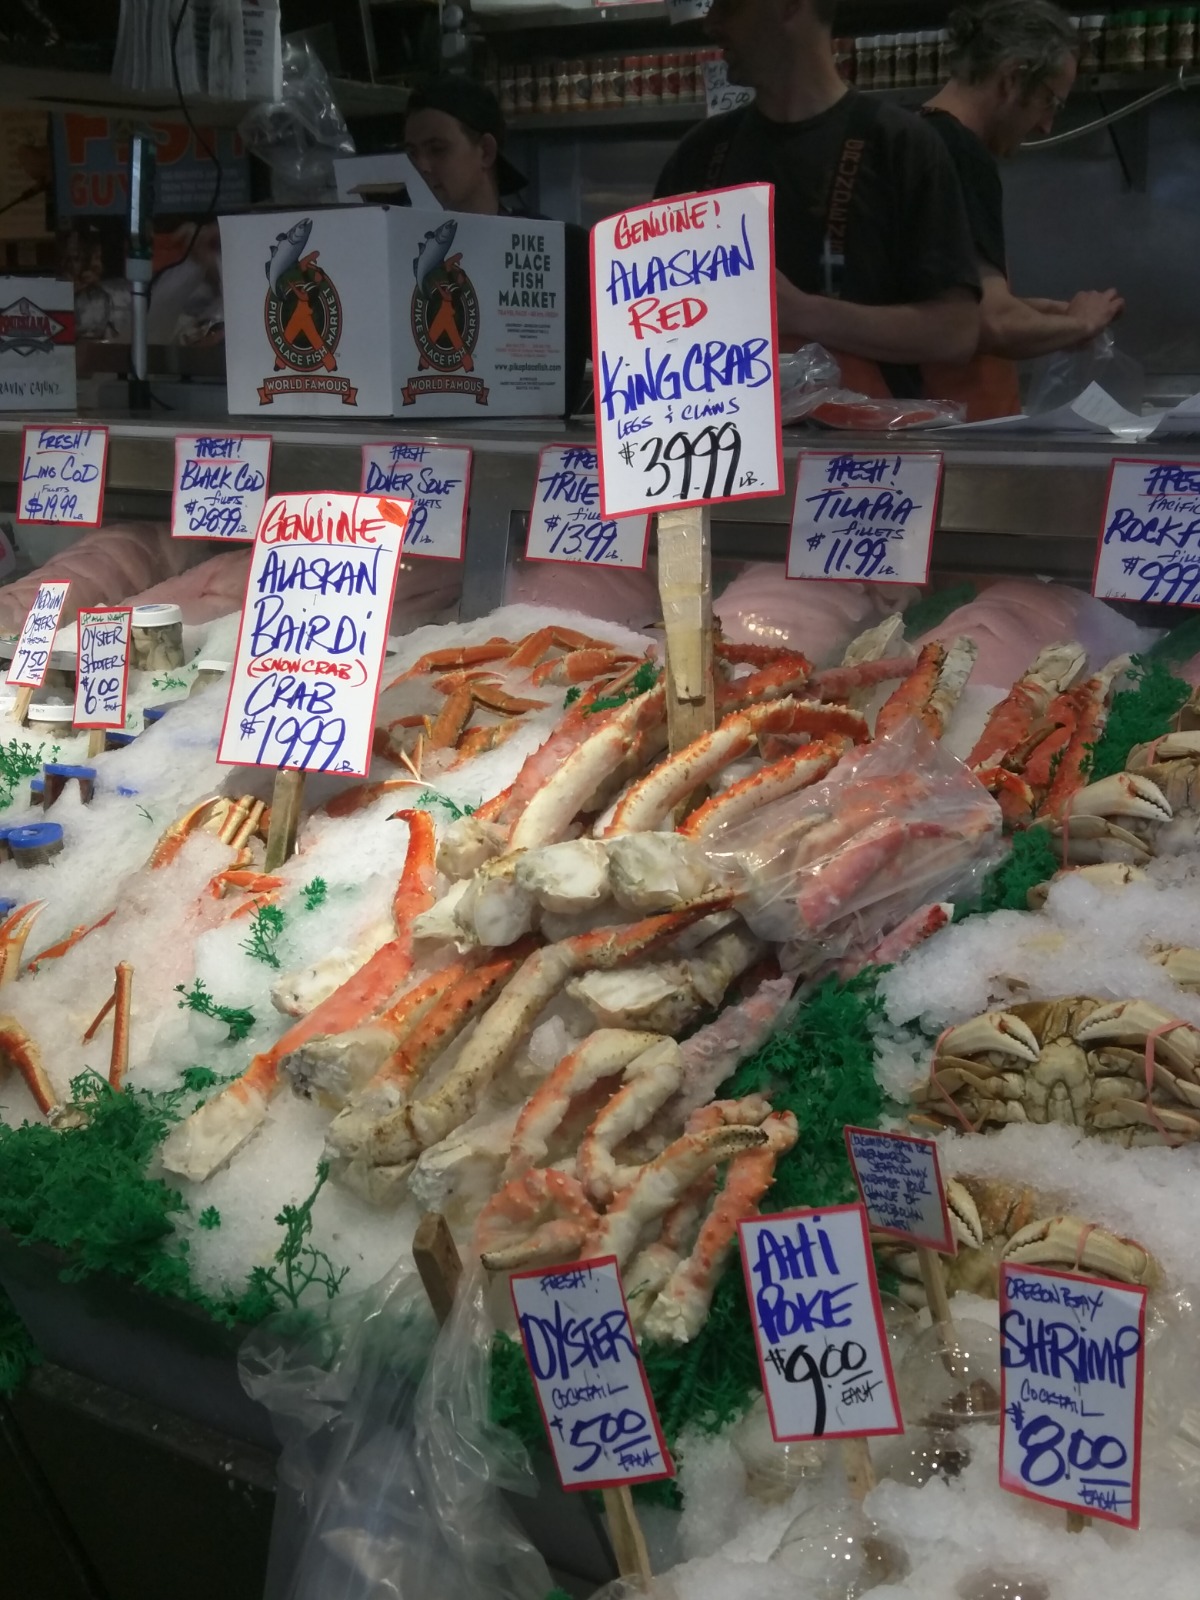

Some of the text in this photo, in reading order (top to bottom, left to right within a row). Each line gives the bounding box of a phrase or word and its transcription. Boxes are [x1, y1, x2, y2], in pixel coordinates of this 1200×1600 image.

[505, 252, 551, 271] PLACE
[512, 234, 544, 252] PIKE
[606, 213, 754, 305] ALASKAN
[498, 290, 556, 308] MARKET
[512, 271, 543, 289] FISH
[268, 287, 338, 366] PIKE PLACE FISH MARKET
[414, 290, 476, 366] PIKE PLACE FISH MARKET
[628, 297, 708, 340] RED
[682, 338, 772, 392] CRAB
[266, 379, 348, 392] WORLD FAMOUS
[410, 379, 482, 392] WORLD FAMOUS
[618, 416, 653, 440] LEGS
[681, 397, 740, 421] CLAWS
[23, 455, 99, 483] LING COD
[180, 459, 265, 492] BLACK COD
[560, 447, 599, 470] FRE
[825, 453, 902, 486] FRESH!
[364, 460, 463, 499] DOVER SOLE
[539, 471, 599, 505] TRUE
[25, 491, 78, 520] $19.99
[260, 496, 386, 544] GENUINE
[414, 498, 442, 509] ILLETS
[805, 481, 923, 526] TILAPIA
[544, 514, 618, 562] $13.99
[1104, 508, 1200, 548] ROCKF
[257, 544, 383, 596] ALASKAN
[806, 532, 889, 578] $11.99
[81, 626, 126, 660] OYSTER
[80, 653, 126, 674] SHOOTERS
[244, 672, 336, 716] CRAB
[240, 714, 346, 773] $19.99
[756, 1282, 859, 1345] POKE
[519, 1299, 641, 1381] OYSTER
[1000, 1309, 1141, 1389] SHRIMP
[552, 1382, 629, 1410] COCKTAIL
[764, 1340, 867, 1437] $9.00
[841, 1379, 884, 1406] EACH
[1021, 1378, 1104, 1416] COCKTAIL
[550, 1408, 647, 1472] $5.00
[1004, 1400, 1128, 1487] $8.00
